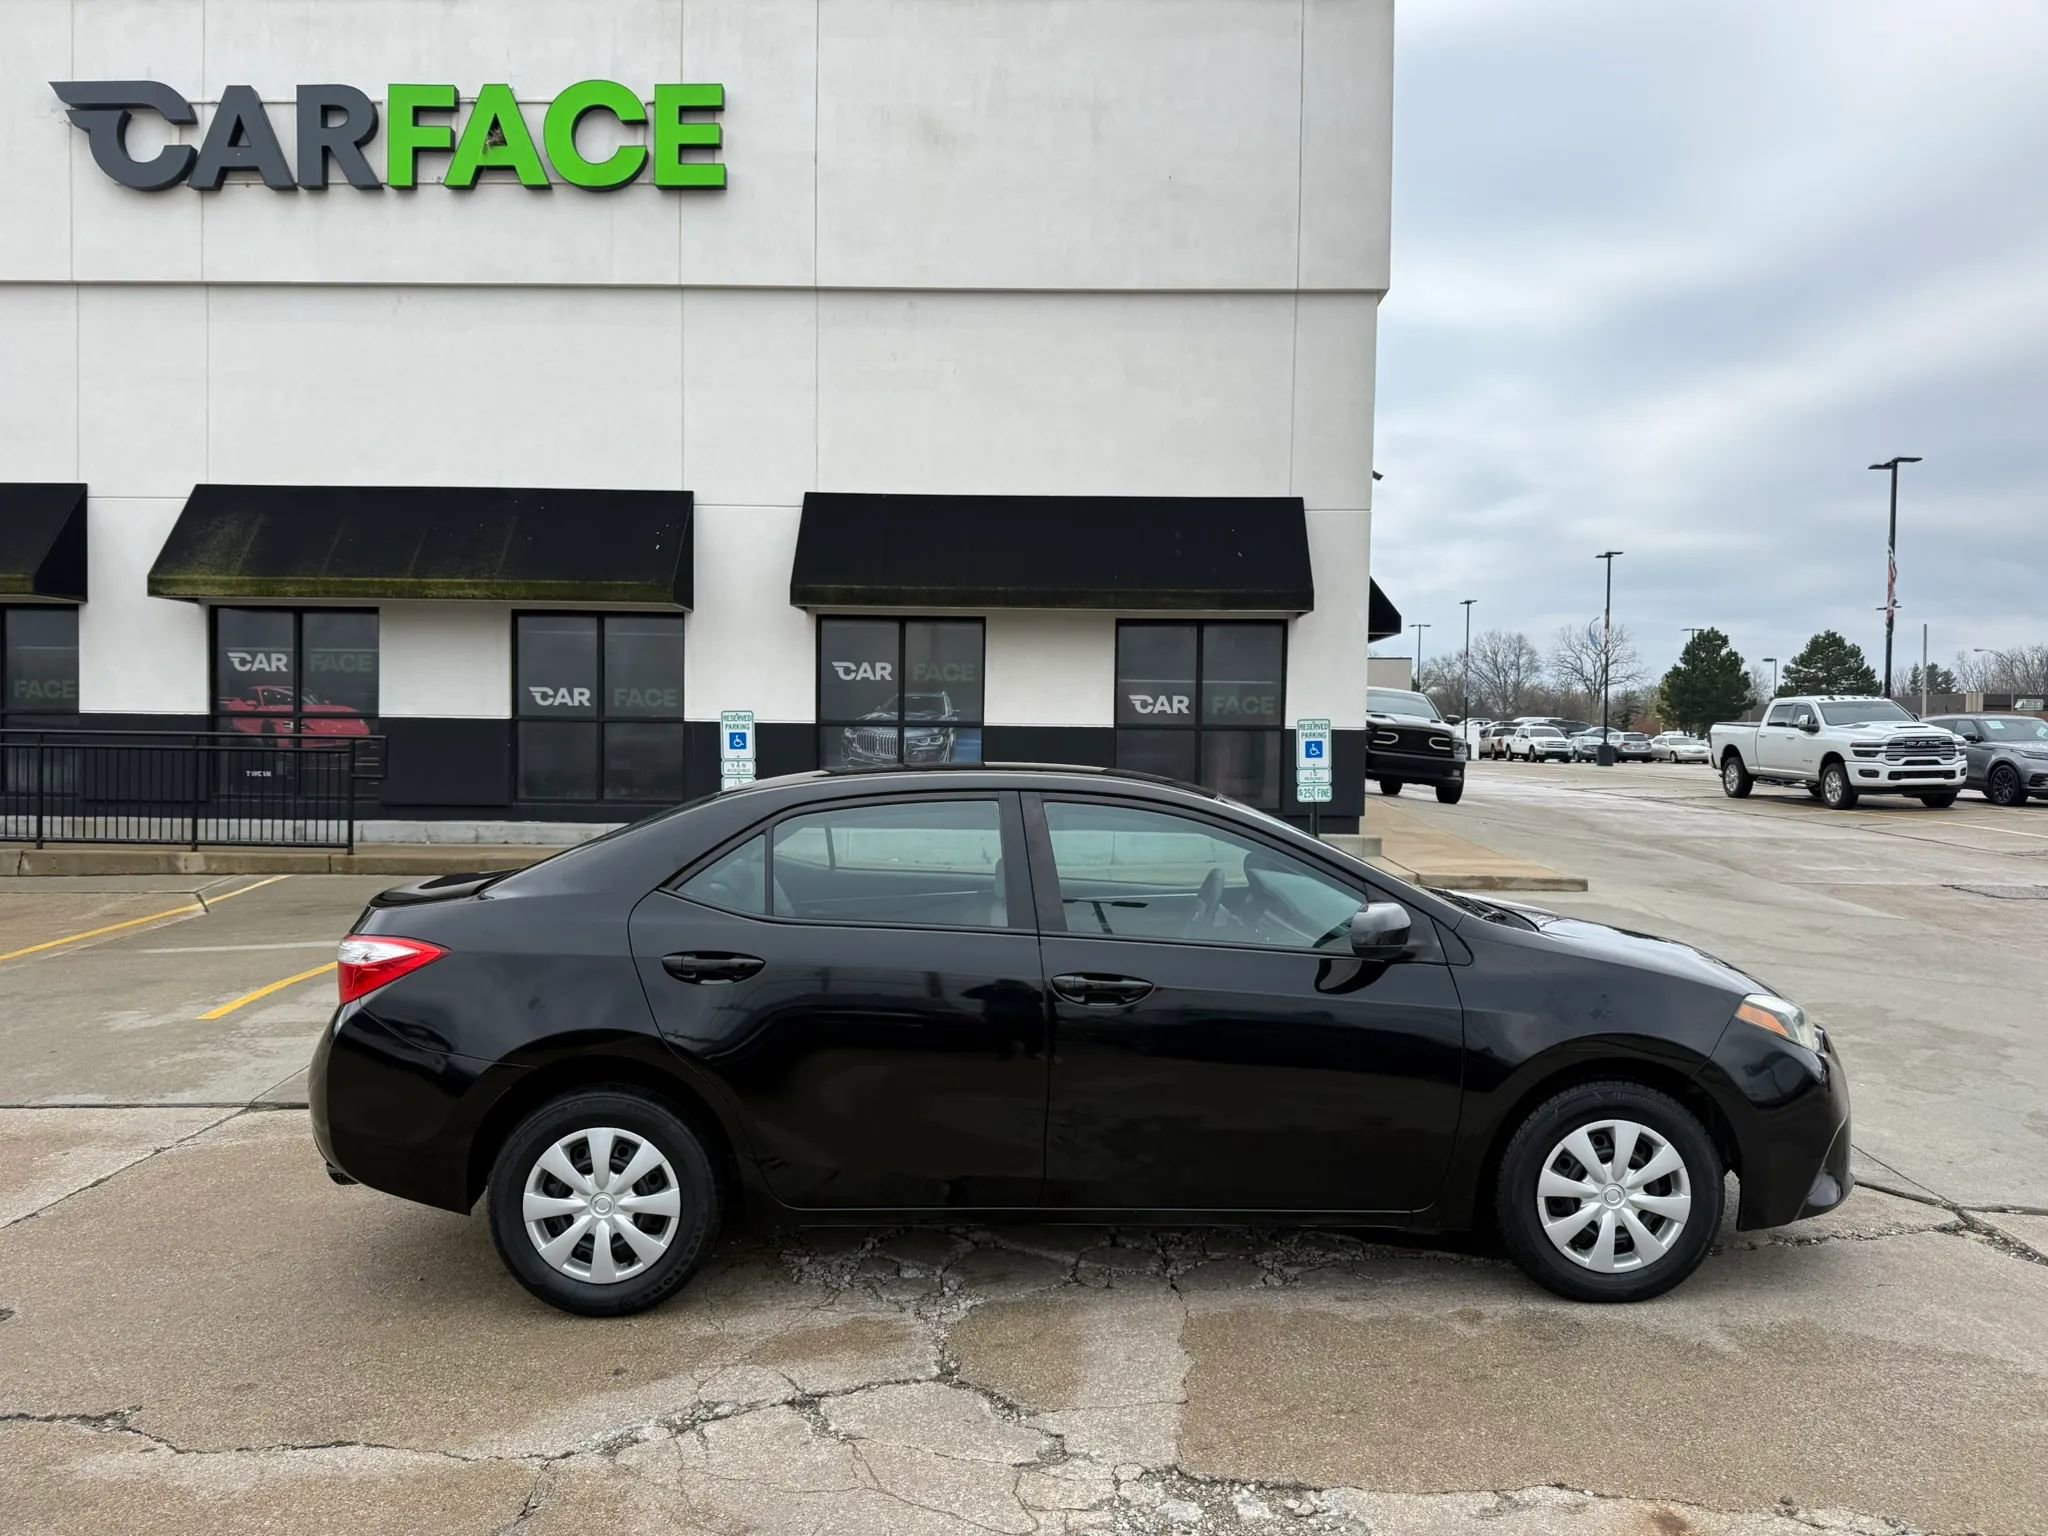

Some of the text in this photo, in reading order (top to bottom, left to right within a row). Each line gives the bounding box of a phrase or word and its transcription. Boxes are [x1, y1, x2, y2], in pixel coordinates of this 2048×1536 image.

[227, 652, 374, 673] CAR FACE
[831, 661, 976, 682] CAR FACE
[14, 680, 77, 699] FACE
[528, 686, 677, 708] CAR FACE
[1128, 694, 1275, 715] CAR FACE
[723, 714, 752, 722] RESERVED
[1300, 723, 1328, 731] RESERVED
[1301, 731, 1327, 739] PARKING
[1298, 788, 1330, 798] $250 FINE
